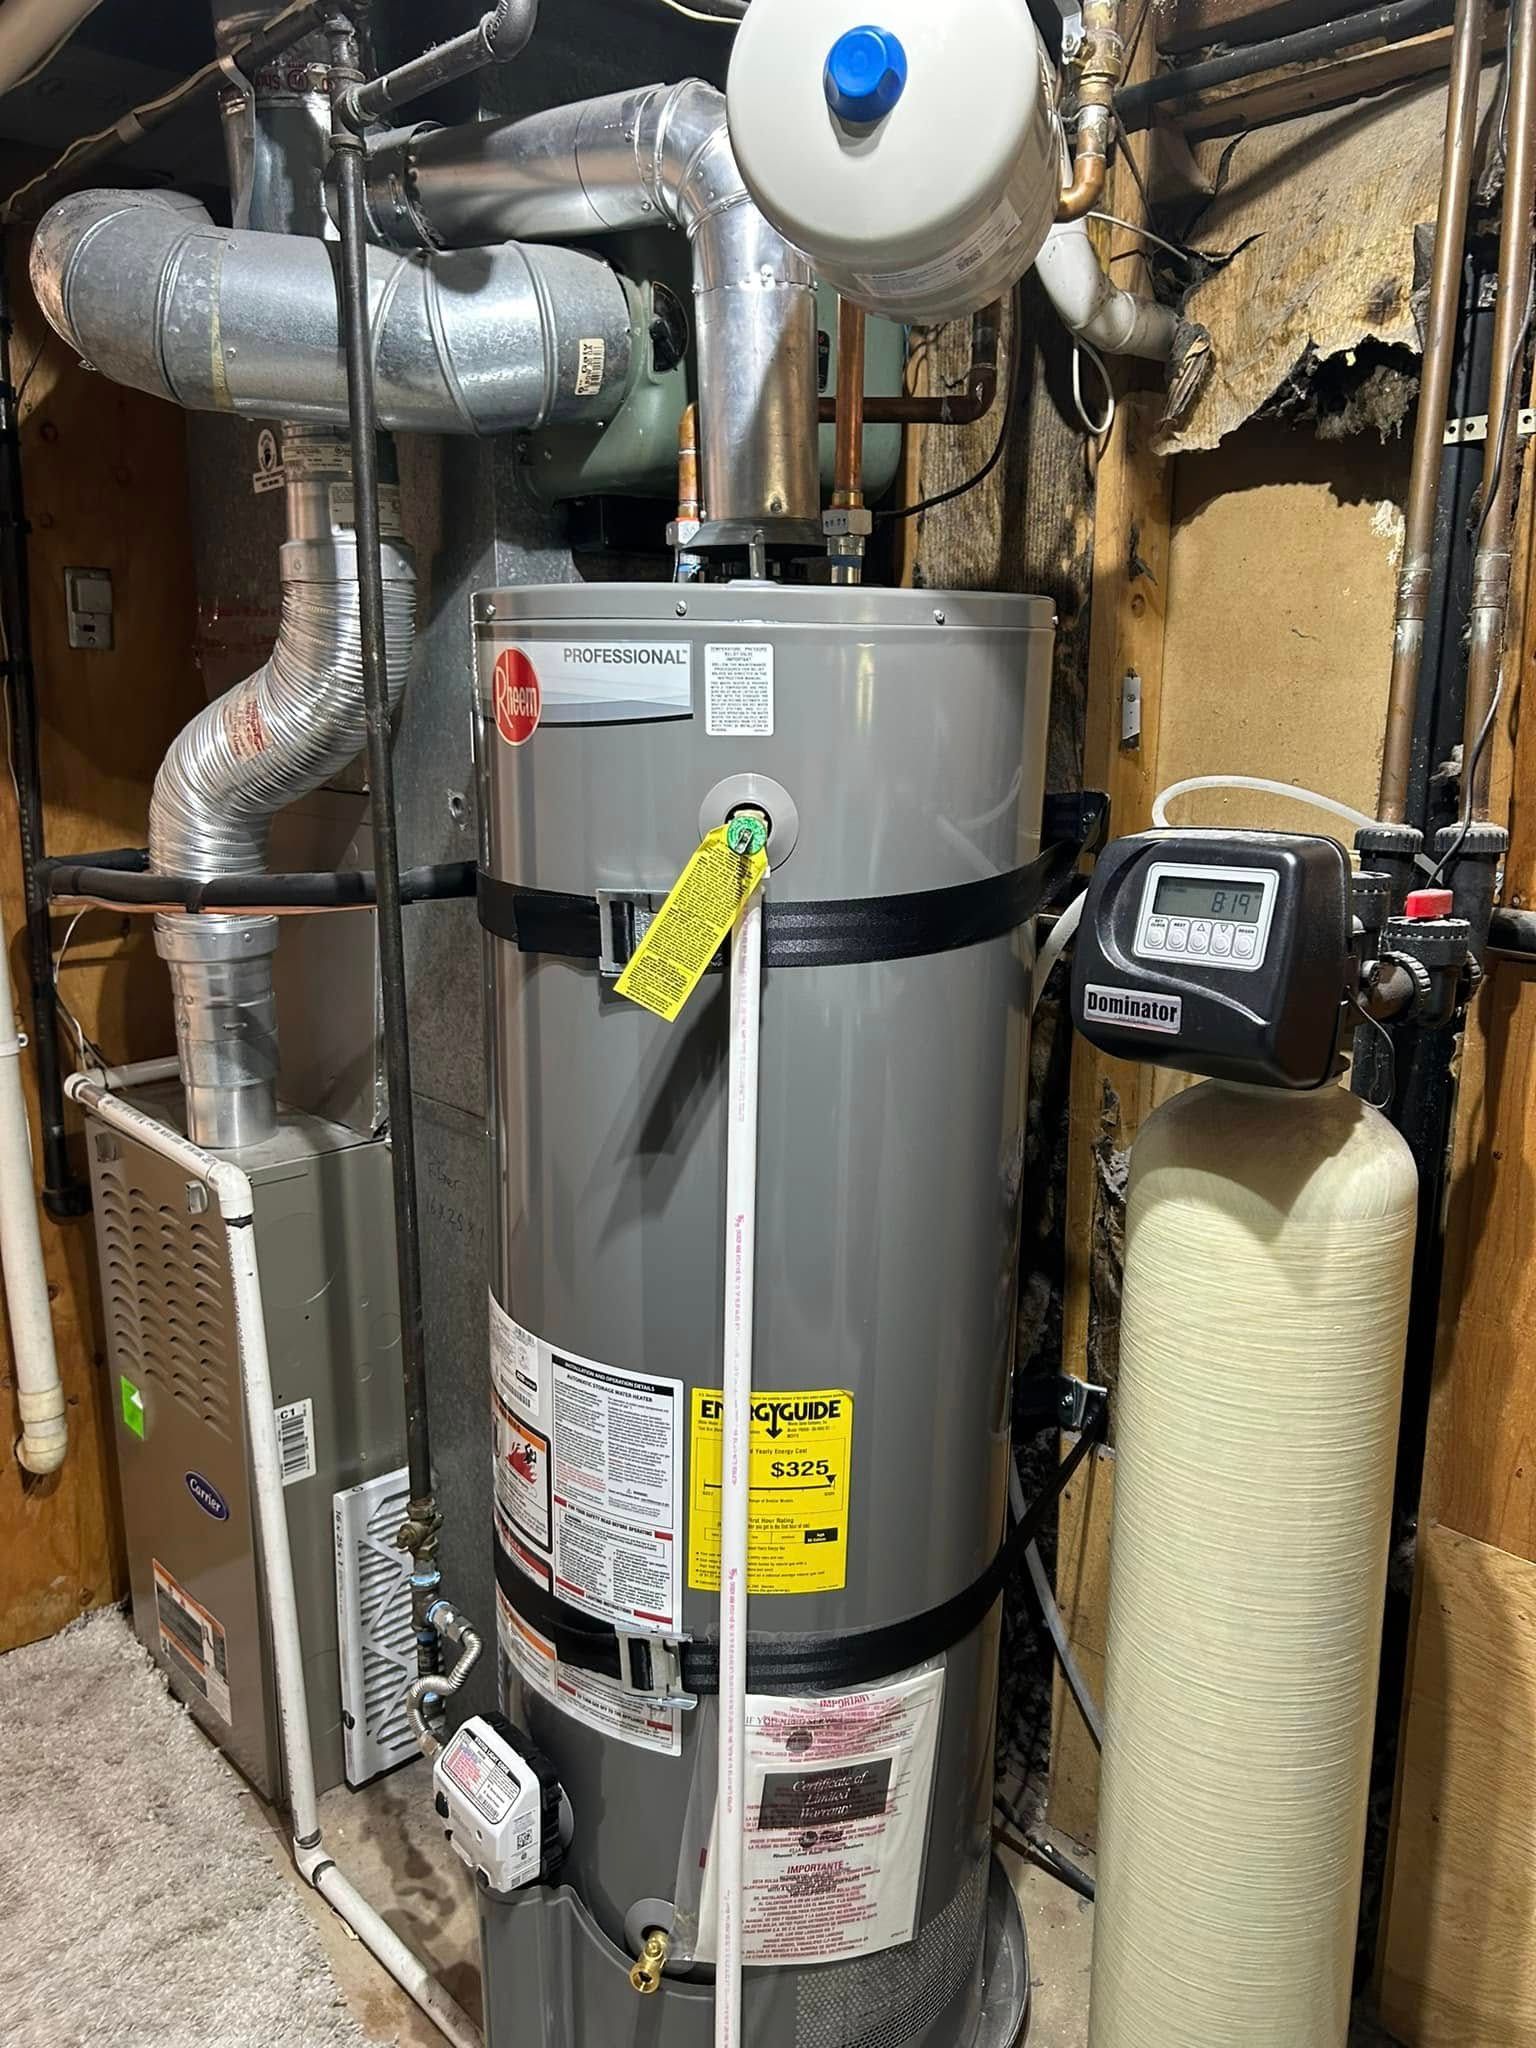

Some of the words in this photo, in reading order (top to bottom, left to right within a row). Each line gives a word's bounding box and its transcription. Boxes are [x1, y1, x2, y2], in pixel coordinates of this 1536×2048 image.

[495, 649, 537, 729] Rheem
[1088, 992, 1177, 1022] Dominator
[565, 1362, 595, 1377] INSTALLATION
[606, 1375, 634, 1388] OPERATION
[634, 1383, 655, 1392] DETAILS
[567, 1374, 592, 1388] AUTOMATIC
[592, 1383, 614, 1394] STORAGE
[615, 1390, 632, 1398] WATER
[633, 1394, 653, 1402] HEATER
[280, 1408, 295, 1419] C1
[701, 1399, 841, 1422] ENGYGUIDE
[771, 1459, 829, 1479] $325
[190, 1479, 221, 1512] Carrier
[336, 1510, 342, 1523] 16
[586, 1511, 600, 1522] SAFETY
[629, 1526, 653, 1536] OPERATING
[819, 1695, 870, 1708] IMPORTANT
[793, 1777, 853, 1792] Certificate
[854, 1770, 869, 1784] of
[805, 1788, 851, 1805] Limited
[800, 1805, 852, 1818] Warranty
[787, 1861, 845, 1874] IMPORTANTE
